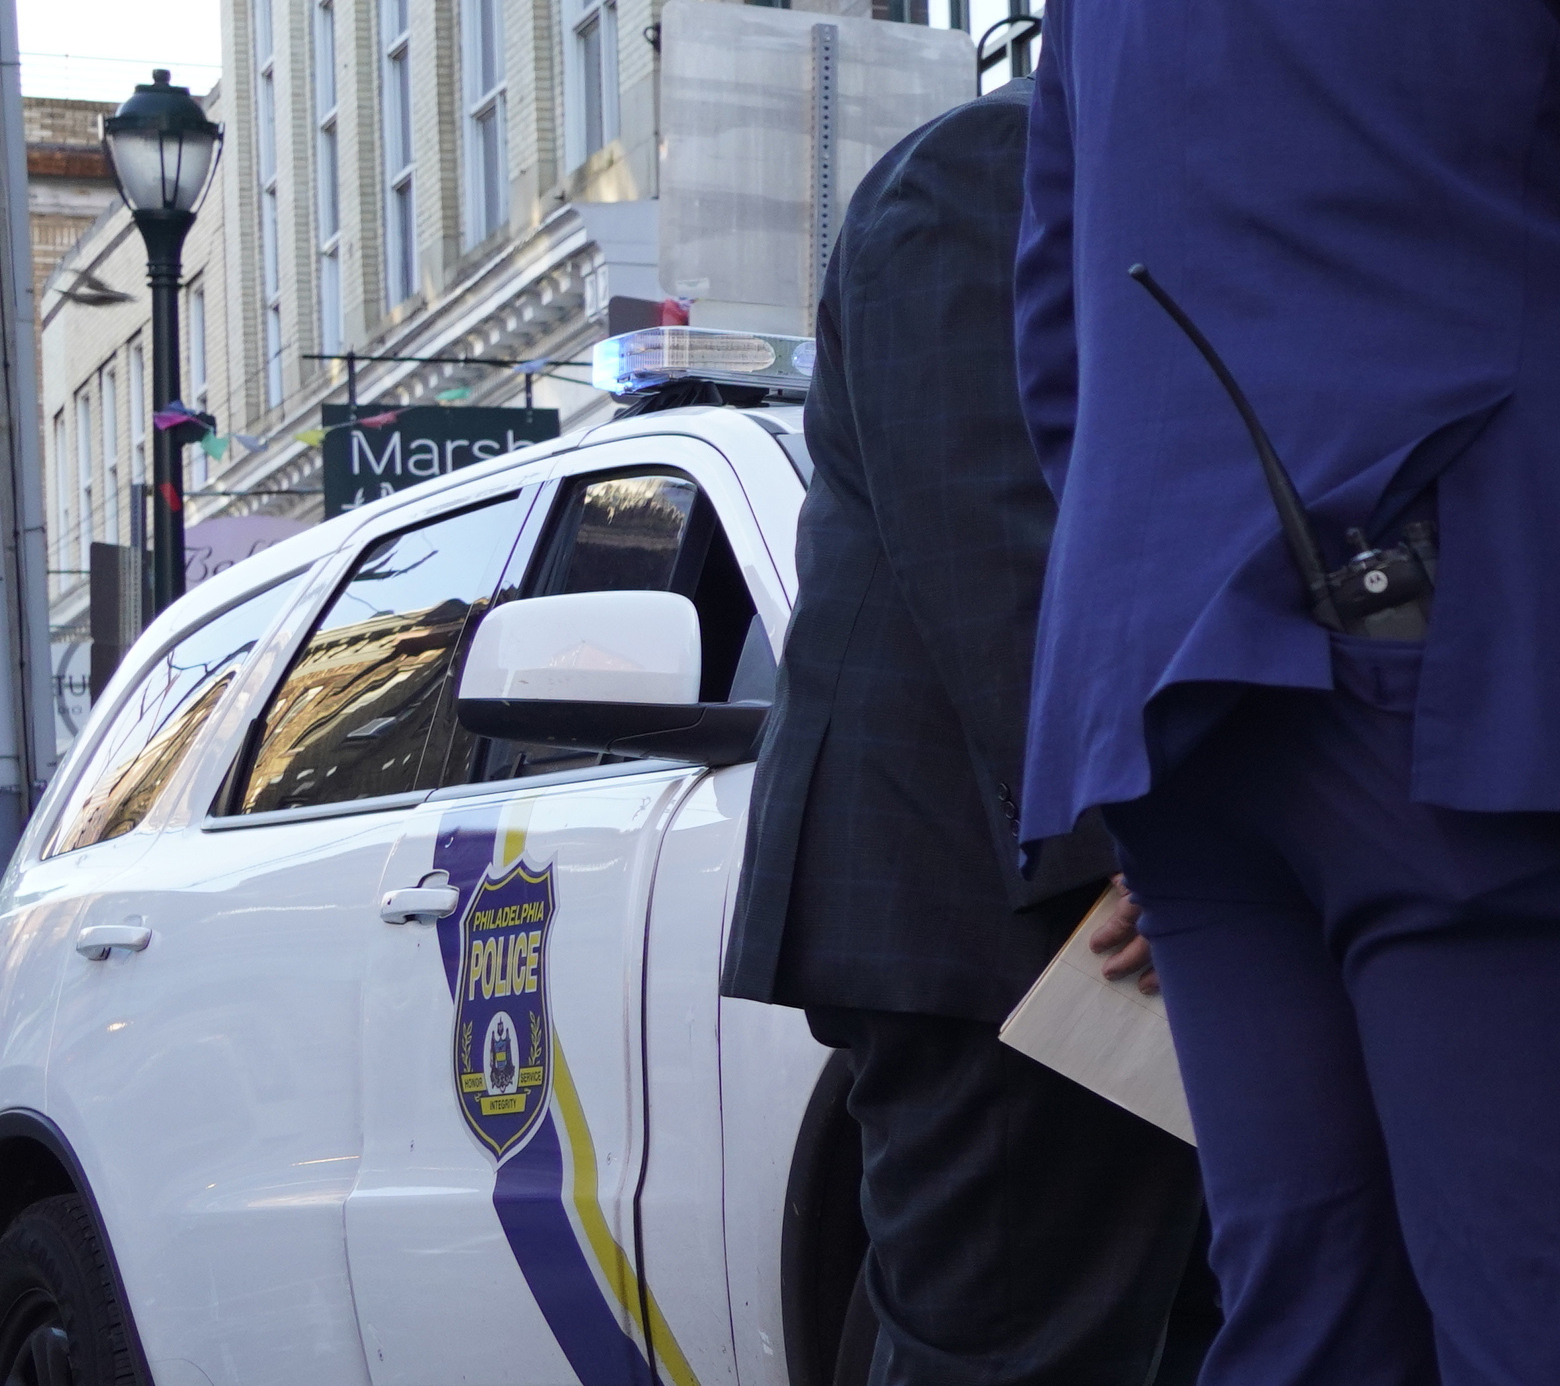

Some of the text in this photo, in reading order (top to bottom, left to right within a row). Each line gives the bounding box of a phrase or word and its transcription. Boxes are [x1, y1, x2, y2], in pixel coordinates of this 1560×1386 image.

[473, 901, 545, 932] PHILADELPHIA
[468, 930, 542, 1001] POLICE
[464, 1070, 542, 1090] HONOR SERVICE
[489, 1098, 517, 1111] INTEGRITY
